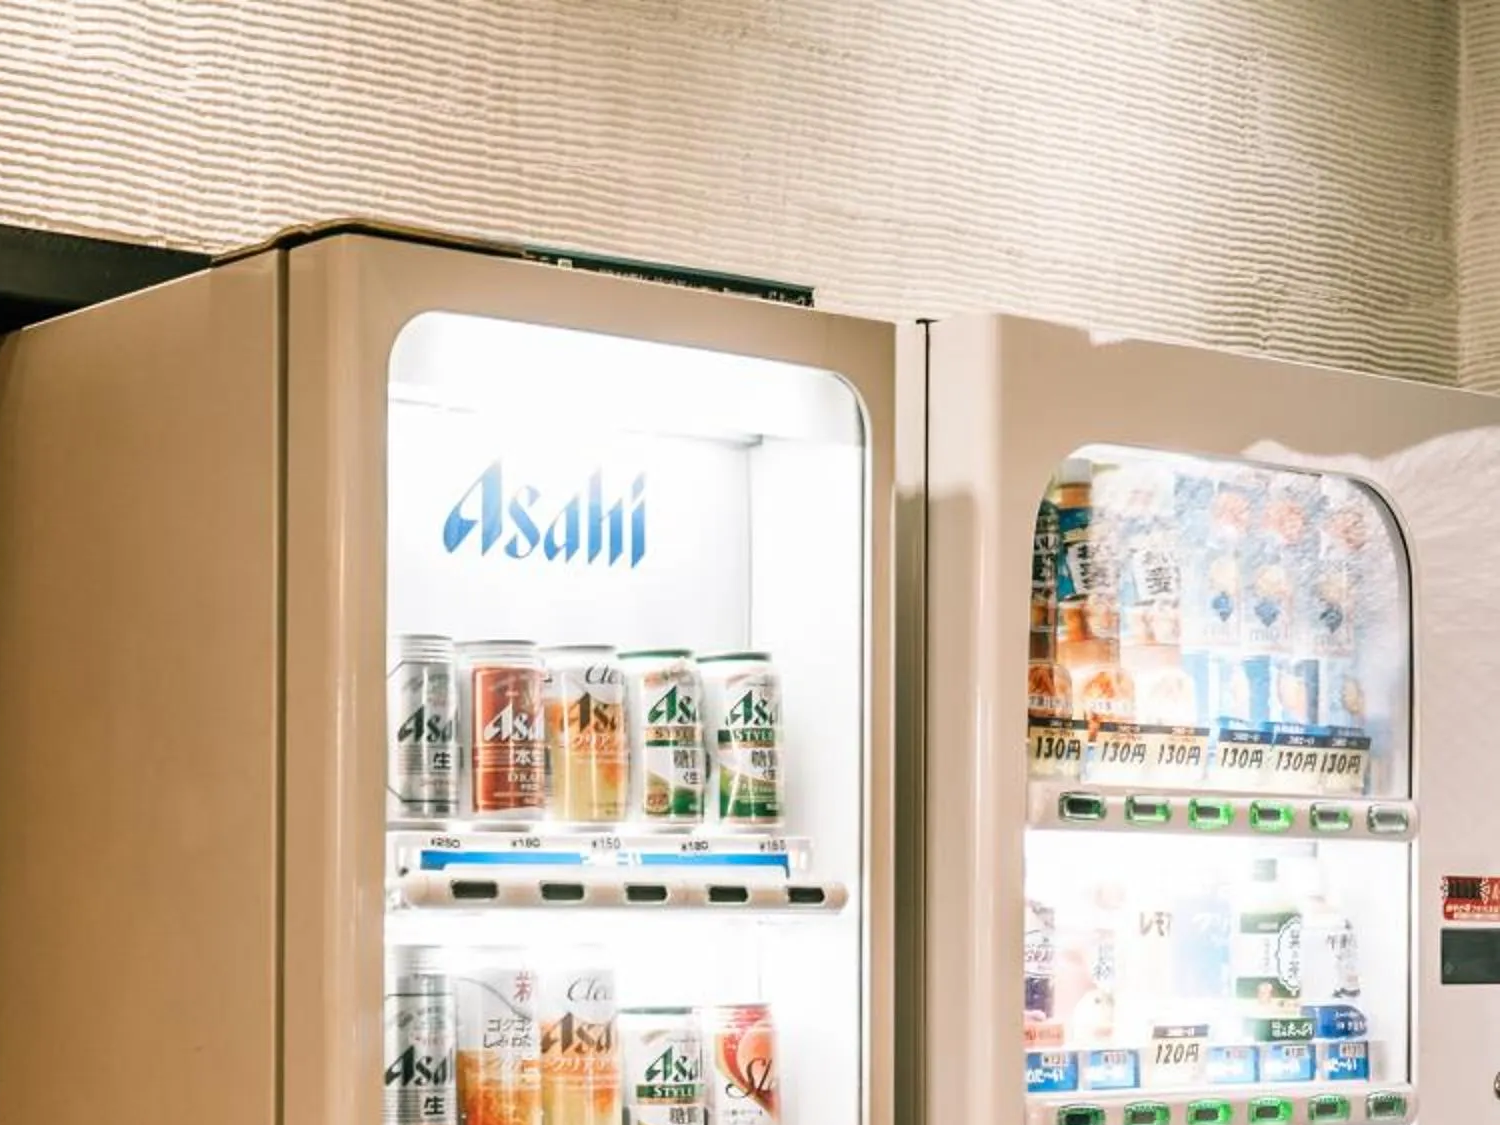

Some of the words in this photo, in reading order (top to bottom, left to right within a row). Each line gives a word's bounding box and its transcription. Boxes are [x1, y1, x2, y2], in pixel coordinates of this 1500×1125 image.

[443, 457, 647, 569] Asahi
[1035, 736, 1081, 760] 130円
[1101, 741, 1146, 763] 130円
[1157, 744, 1201, 765] 130円
[1221, 747, 1263, 768] 130円
[1275, 751, 1318, 772] 130円
[1320, 752, 1362, 774] 130円
[1155, 1043, 1200, 1065] 120円
[424, 1096, 445, 1116] 生
